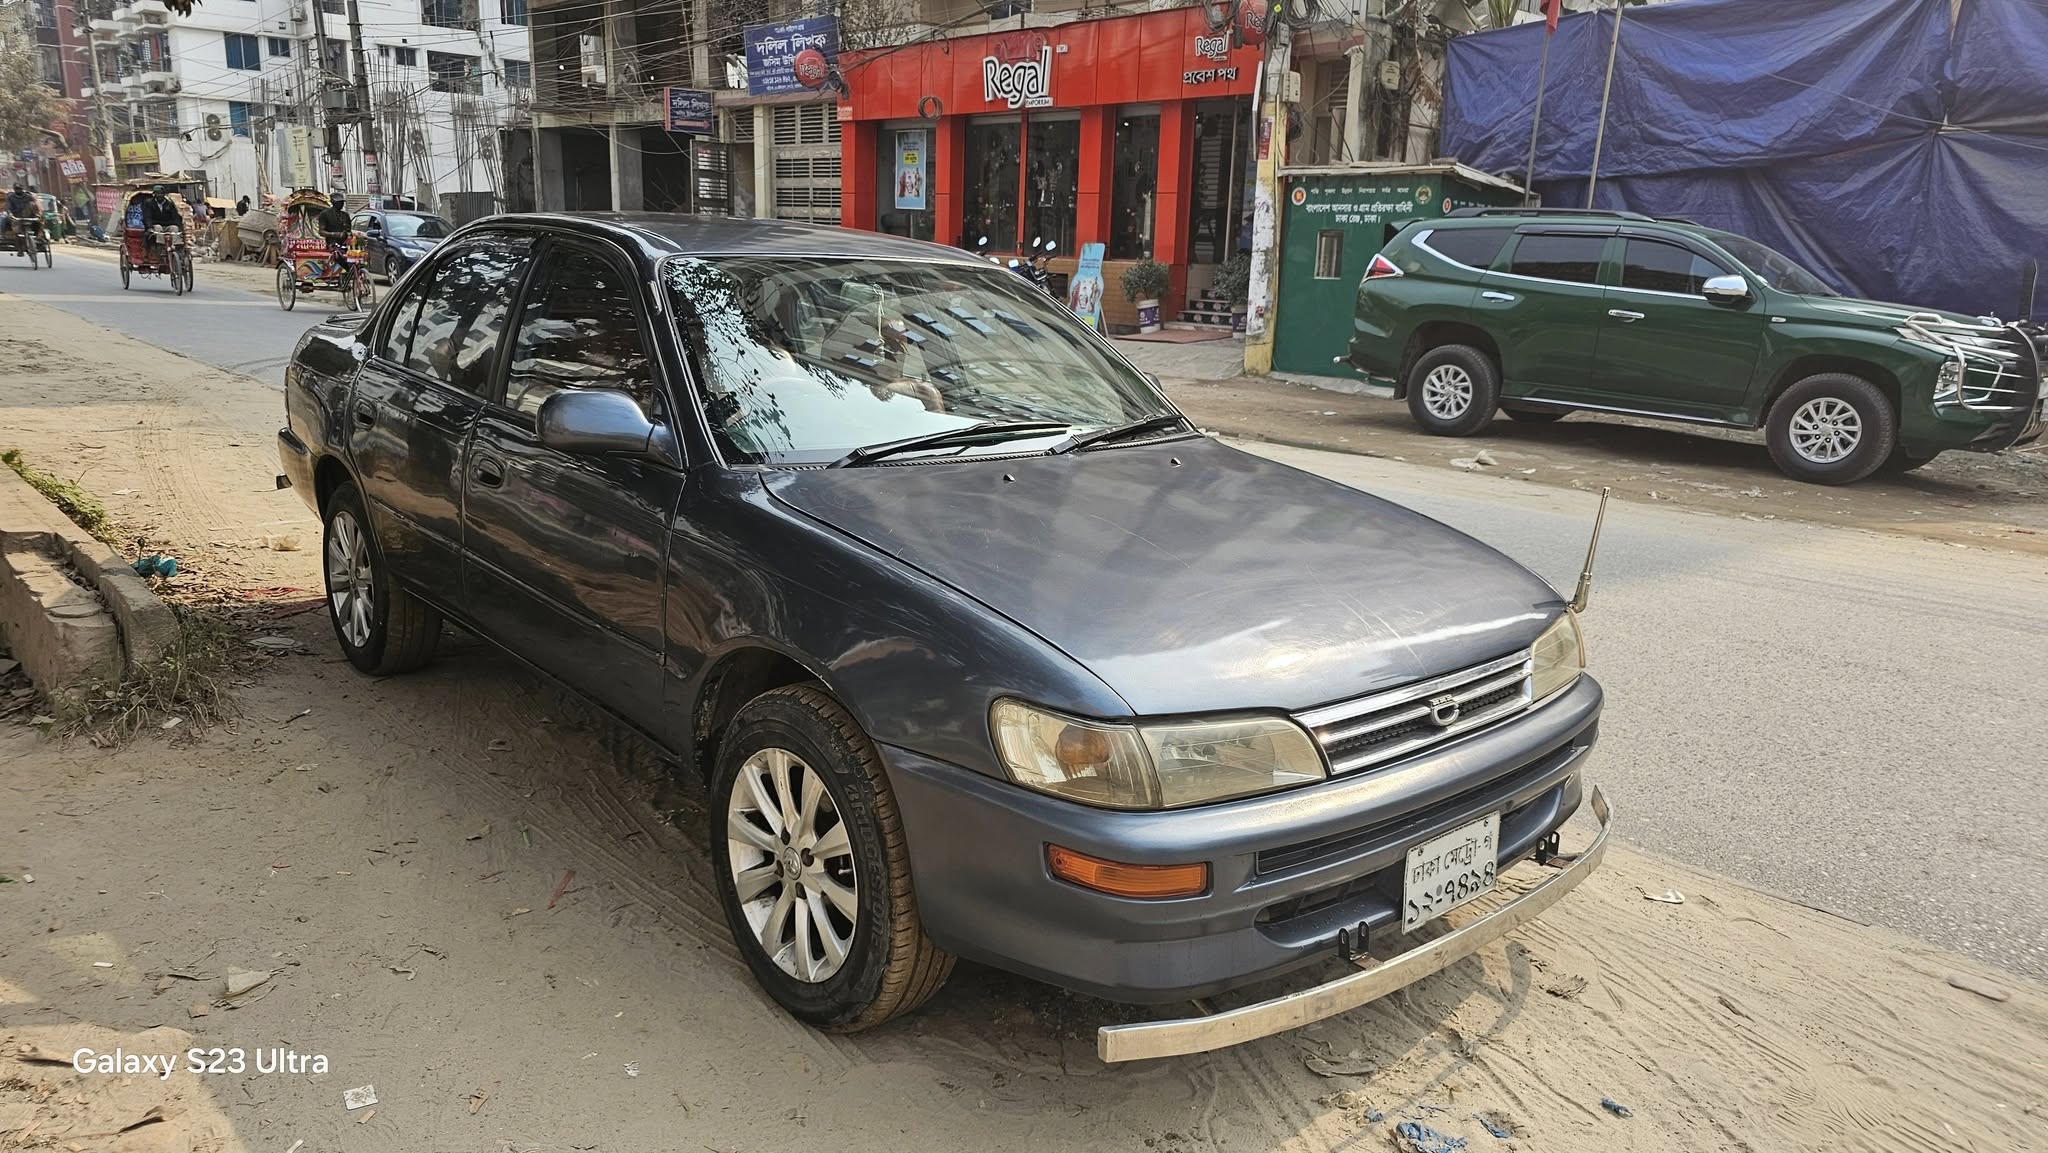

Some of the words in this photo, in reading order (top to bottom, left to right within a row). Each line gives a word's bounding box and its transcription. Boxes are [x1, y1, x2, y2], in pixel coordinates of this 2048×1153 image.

[755, 37, 789, 55] দলিল
[790, 33, 828, 52] লিখক
[1195, 29, 1231, 58] Regal
[800, 63, 826, 79] Regal
[983, 46, 1052, 108] Regal
[1183, 69, 1216, 84] প্রবেশ
[1217, 66, 1237, 81] পথ
[1411, 855, 1441, 884] ঢাকা
